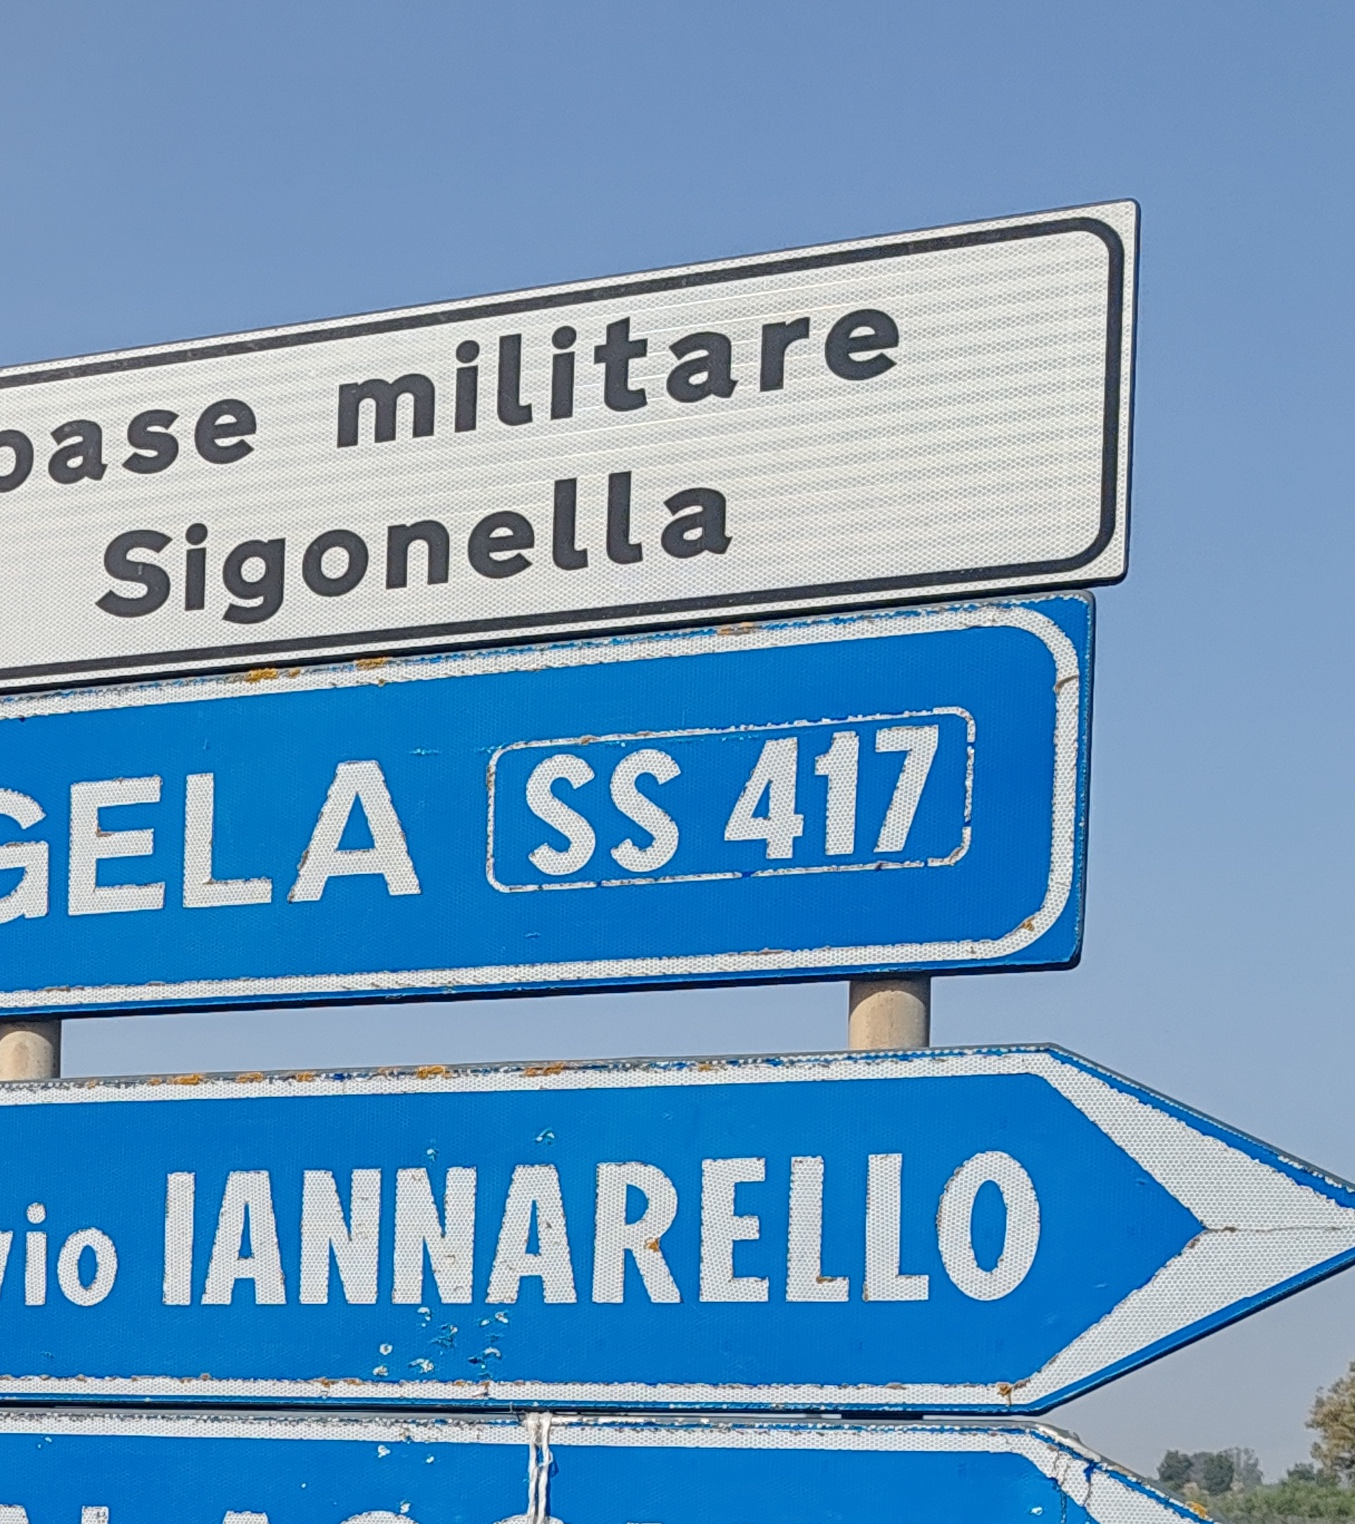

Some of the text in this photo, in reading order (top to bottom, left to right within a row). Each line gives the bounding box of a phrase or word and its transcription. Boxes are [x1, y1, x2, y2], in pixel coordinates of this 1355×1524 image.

[336, 308, 900, 449] militare
[95, 470, 733, 625] Sigonella
[525, 748, 681, 876] SS
[724, 724, 939, 860] 417
[161, 1150, 1041, 1306] IANNARELLO
